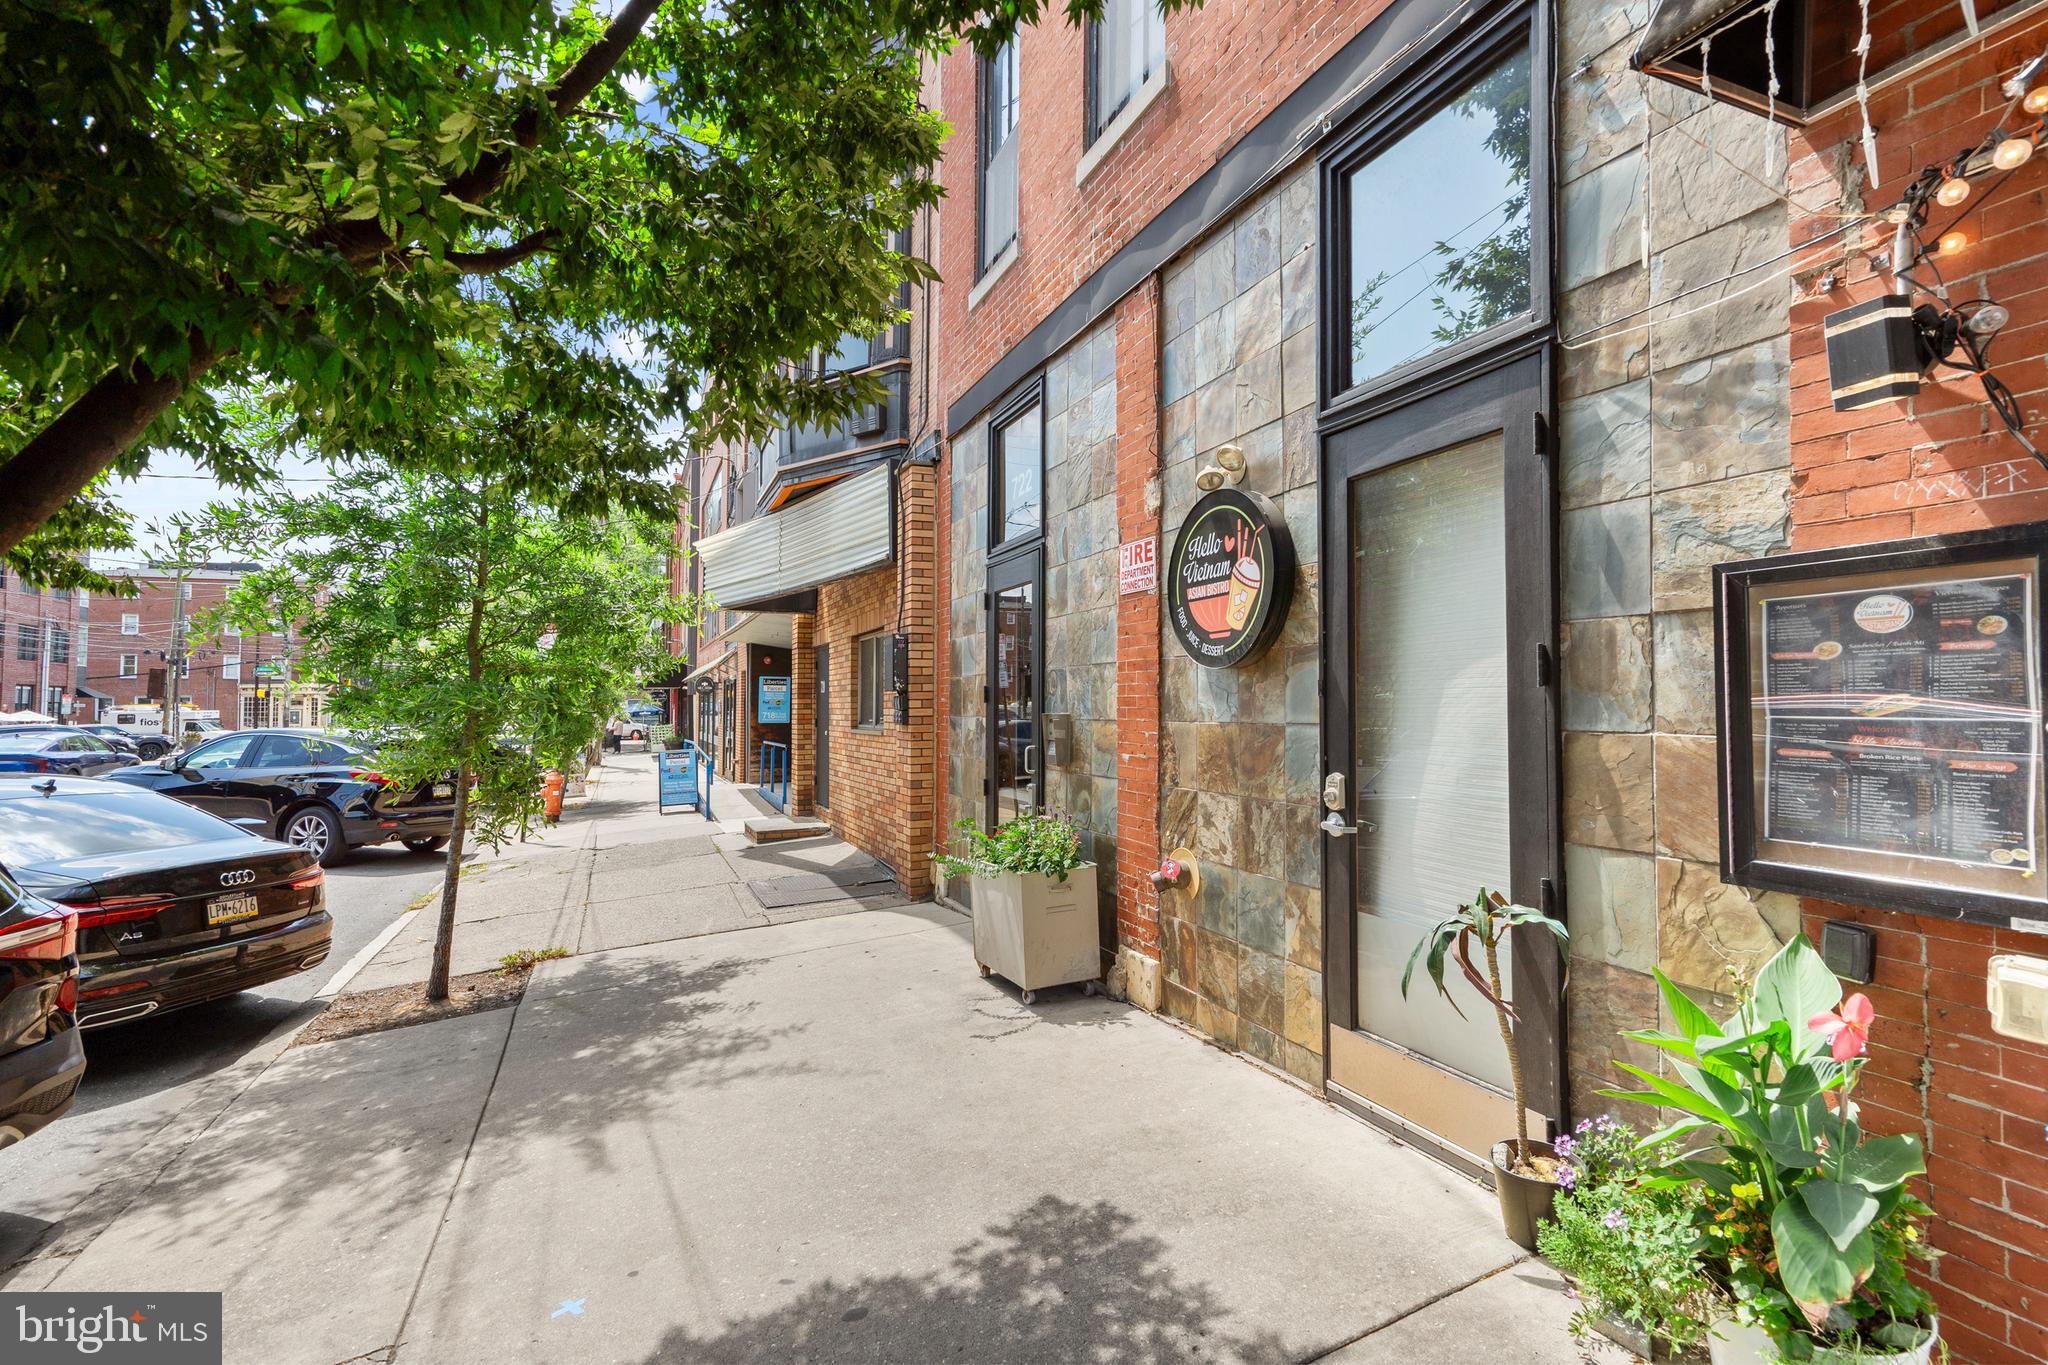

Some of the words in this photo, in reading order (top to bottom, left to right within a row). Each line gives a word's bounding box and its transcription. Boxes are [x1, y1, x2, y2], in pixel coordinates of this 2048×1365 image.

[1011, 468, 1033, 501] 722
[1121, 541, 1153, 568] FIRE
[1188, 532, 1223, 561] Hello
[1121, 564, 1154, 581] DEPARTMENT
[1121, 576, 1154, 592] CONNECTION
[1183, 559, 1232, 584] Vietnam
[1187, 585, 1206, 600] ASIAN
[1207, 580, 1229, 595] BISTRO
[1176, 606, 1188, 627] FOOD
[1186, 630, 1200, 648] JUICE
[1201, 643, 1225, 656] DESSERT
[140, 718, 160, 726] fios
